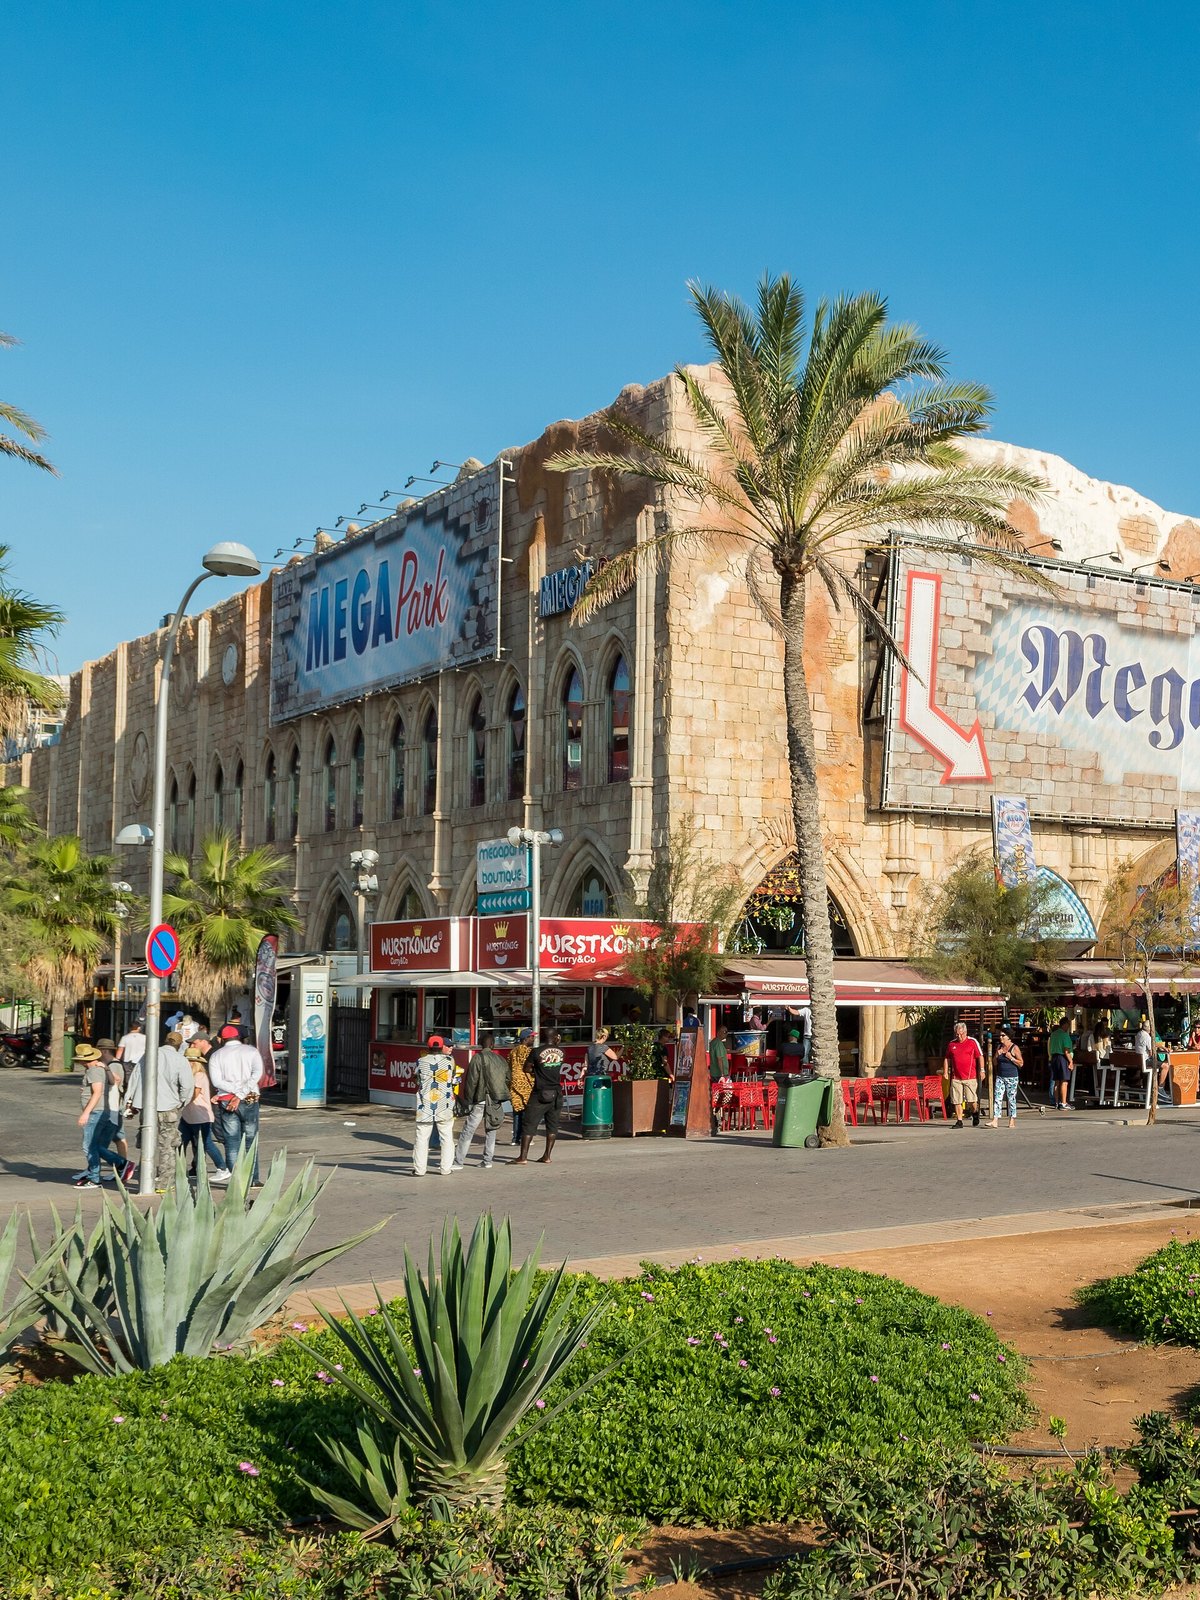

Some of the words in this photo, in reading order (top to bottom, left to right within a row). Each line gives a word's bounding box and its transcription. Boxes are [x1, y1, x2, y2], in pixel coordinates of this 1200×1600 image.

[305, 559, 394, 673] MEGA
[394, 547, 450, 640] Park
[482, 868, 522, 884] boutique
[551, 954, 596, 964] Curry&Co
